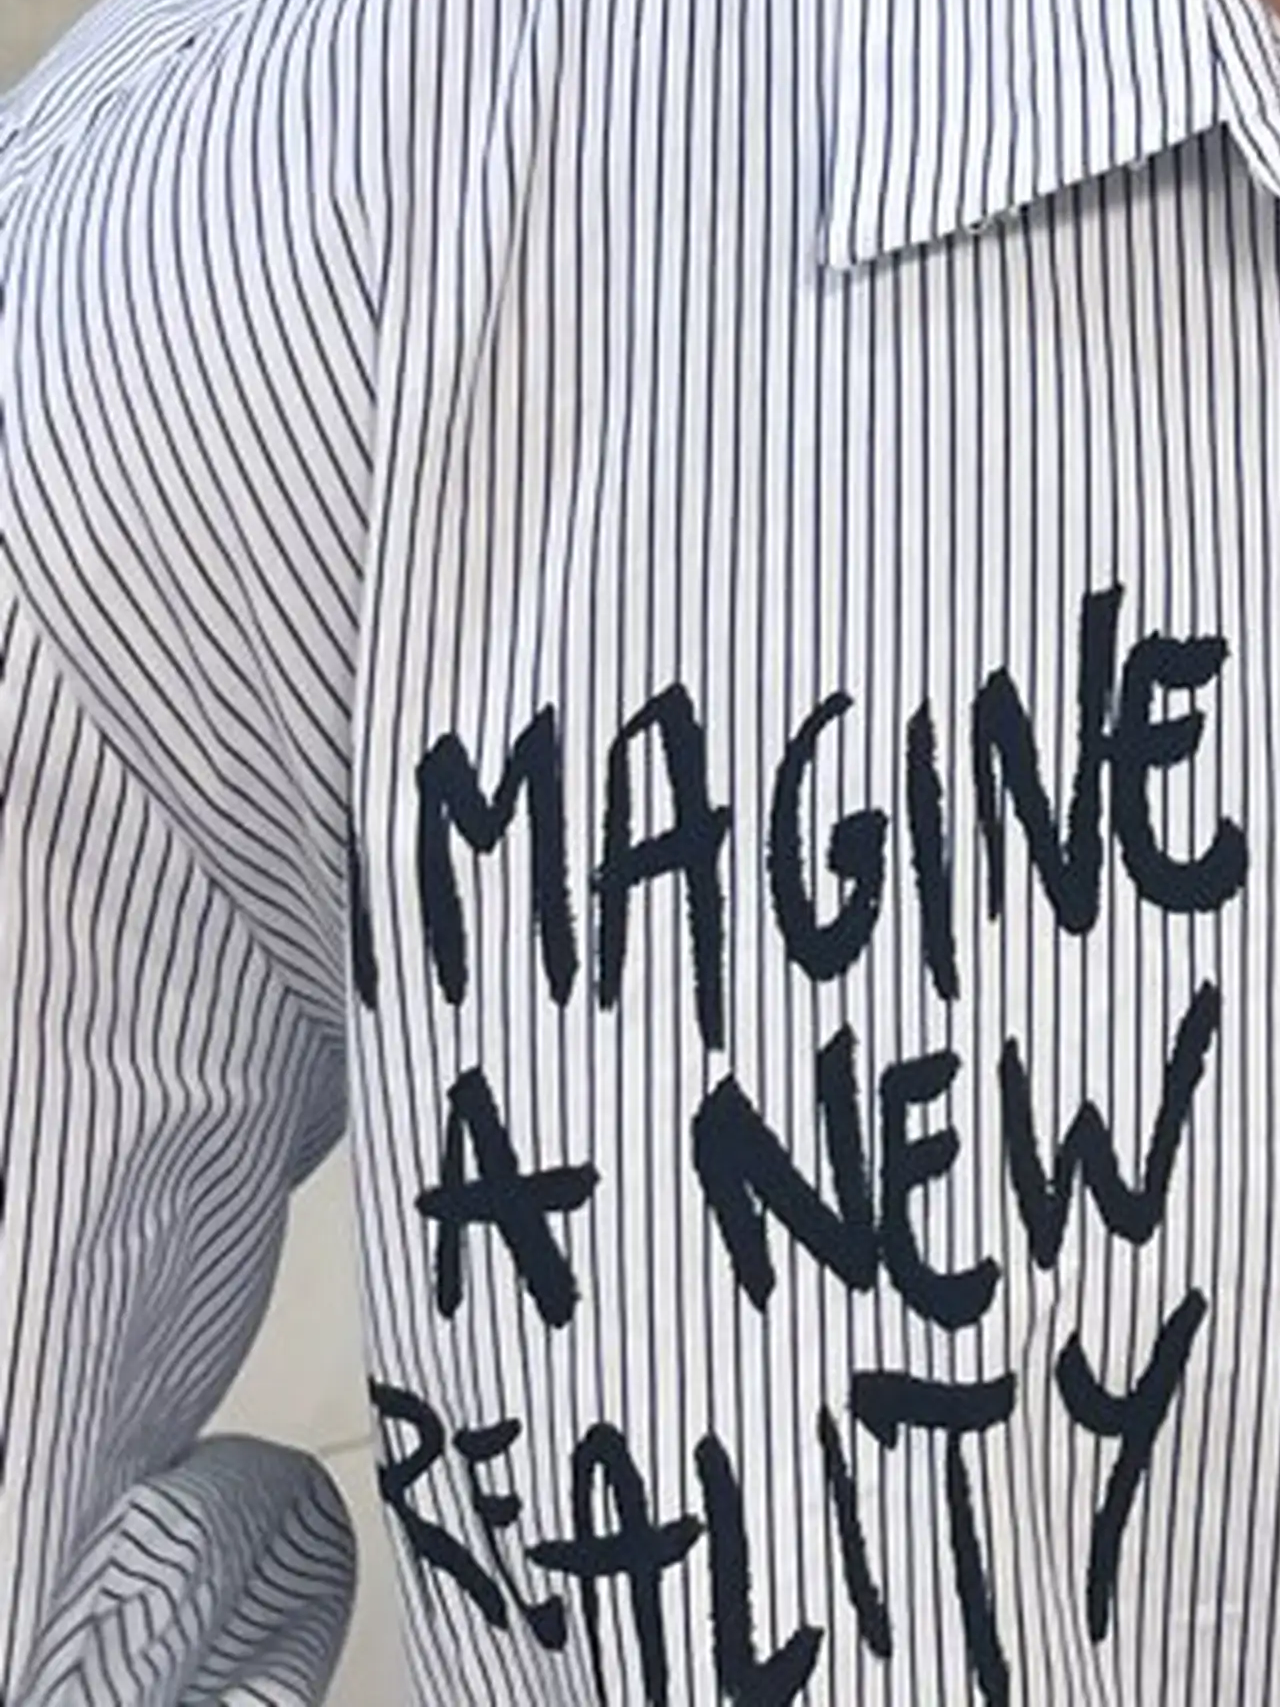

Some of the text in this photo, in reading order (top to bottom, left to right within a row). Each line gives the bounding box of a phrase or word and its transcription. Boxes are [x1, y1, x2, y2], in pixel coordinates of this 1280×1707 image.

[416, 981, 1222, 1330] A NEW
[368, 1289, 1206, 1707] REALITY
